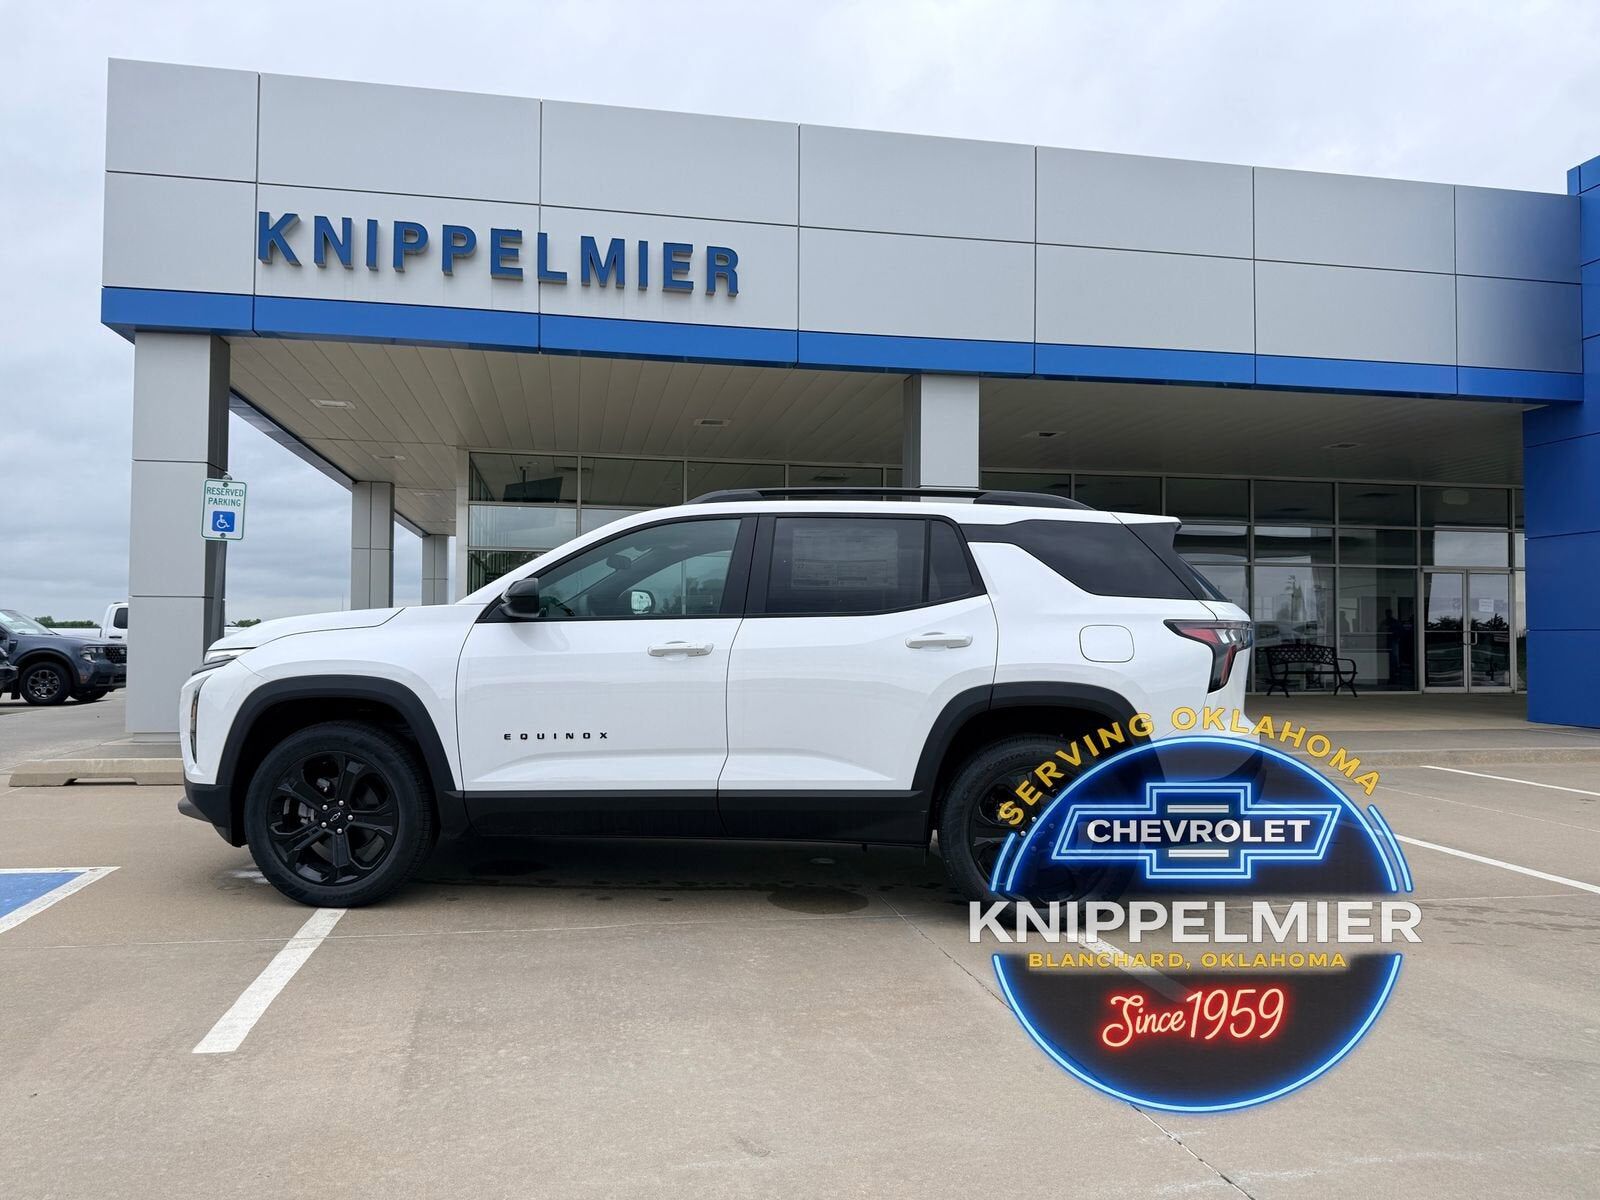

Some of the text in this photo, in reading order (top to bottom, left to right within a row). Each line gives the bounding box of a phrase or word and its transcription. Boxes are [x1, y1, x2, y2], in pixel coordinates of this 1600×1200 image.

[258, 211, 739, 297] KNIPPELMIER
[206, 486, 244, 497] RESERVED
[207, 497, 241, 507] PARKING
[503, 732, 608, 741] EQUINOX
